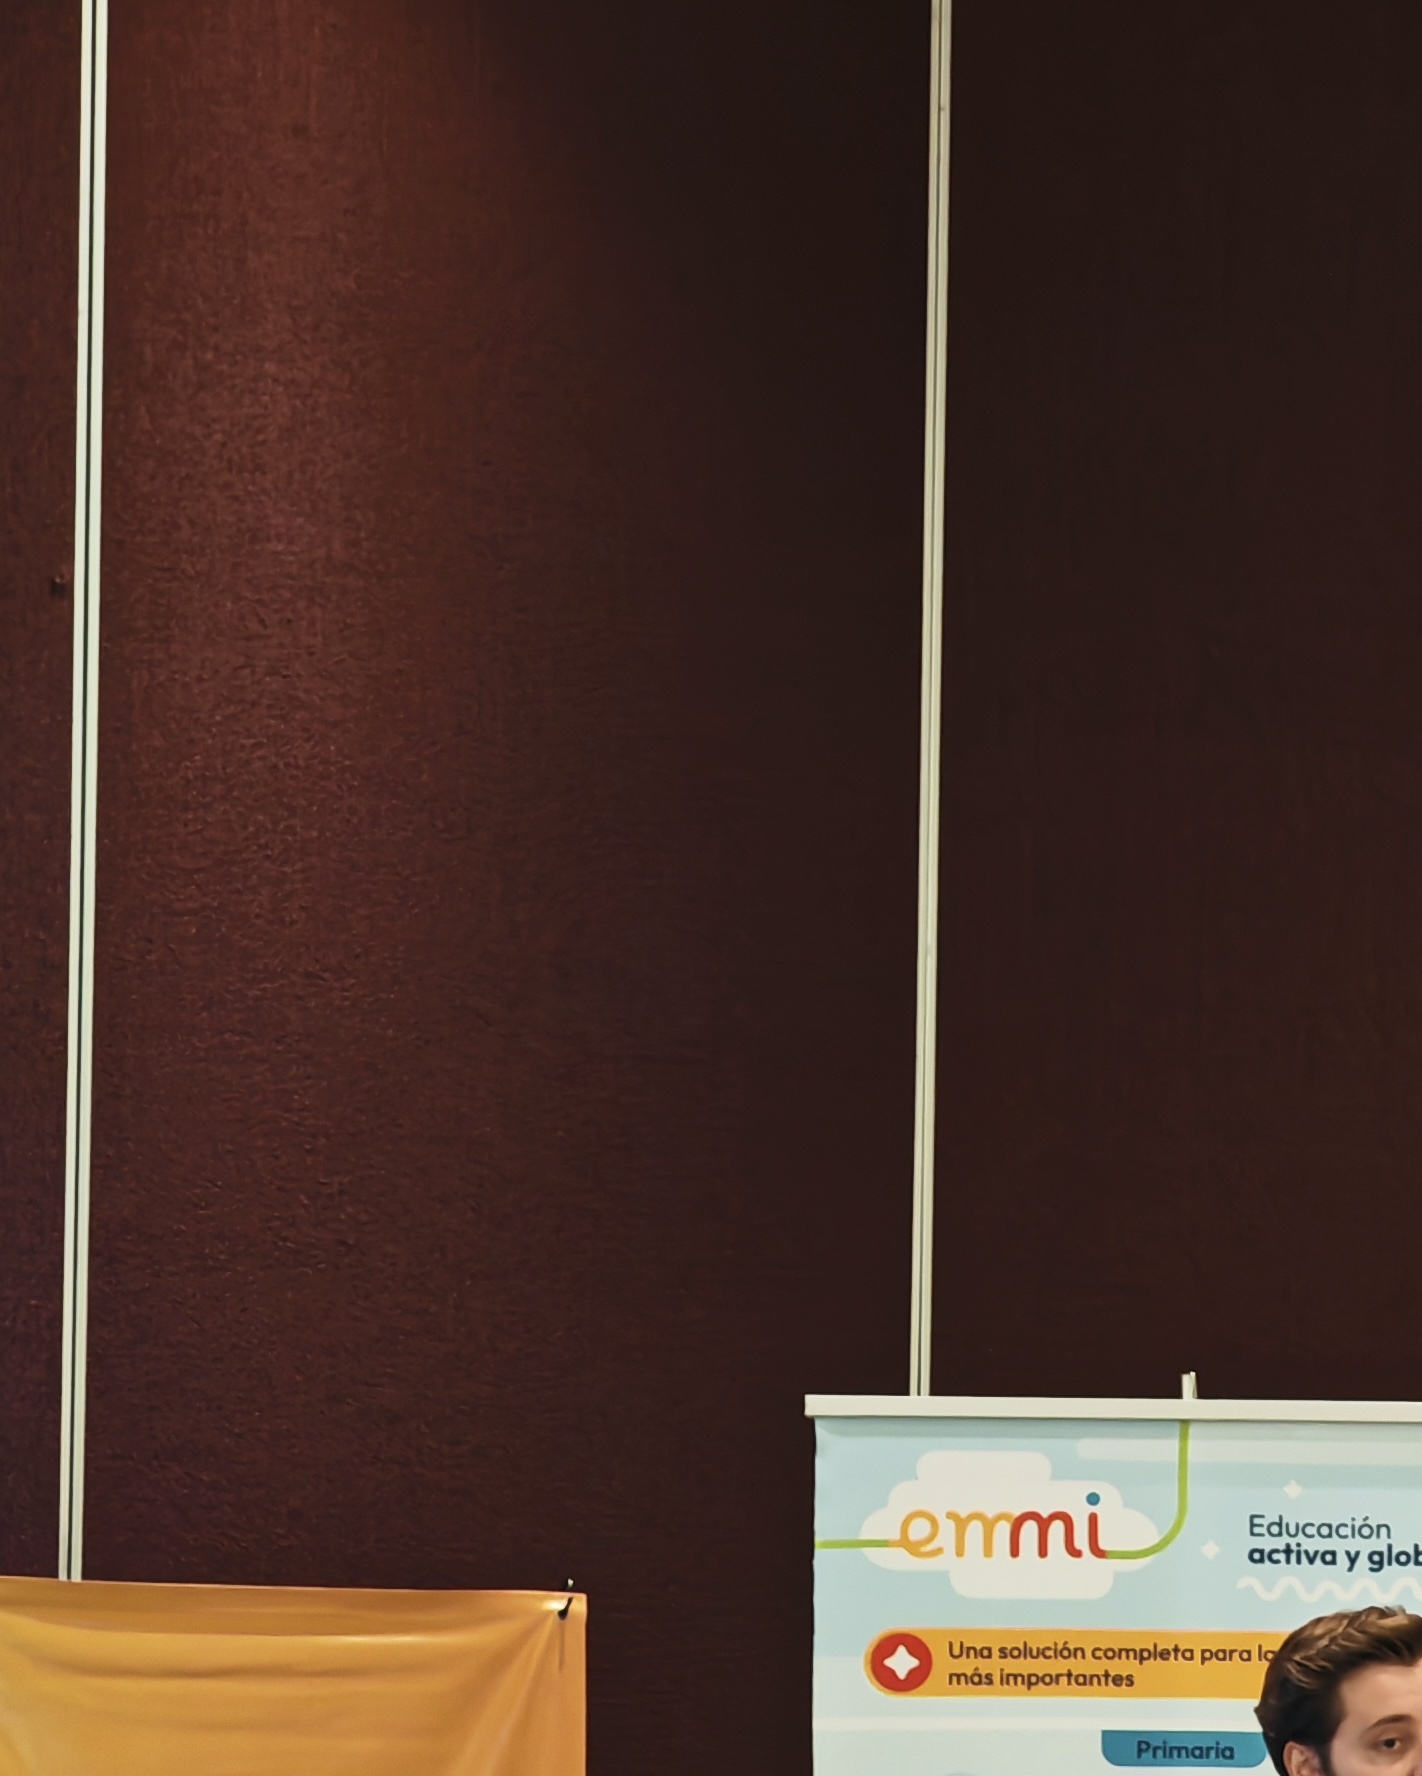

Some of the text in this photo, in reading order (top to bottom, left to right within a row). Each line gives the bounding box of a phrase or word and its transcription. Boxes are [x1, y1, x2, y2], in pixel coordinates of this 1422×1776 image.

[890, 1491, 1108, 1559] emmi
[1248, 1514, 1391, 1540] Educación
[1248, 1544, 1336, 1567] activa
[1344, 1549, 1361, 1573] y
[948, 1641, 993, 1660] Una
[999, 1641, 1086, 1661] solución
[1091, 1643, 1195, 1665] completa
[1200, 1649, 1252, 1668] para
[948, 1667, 1135, 1691] más importantes
[1136, 1740, 1236, 1761] Primaria
